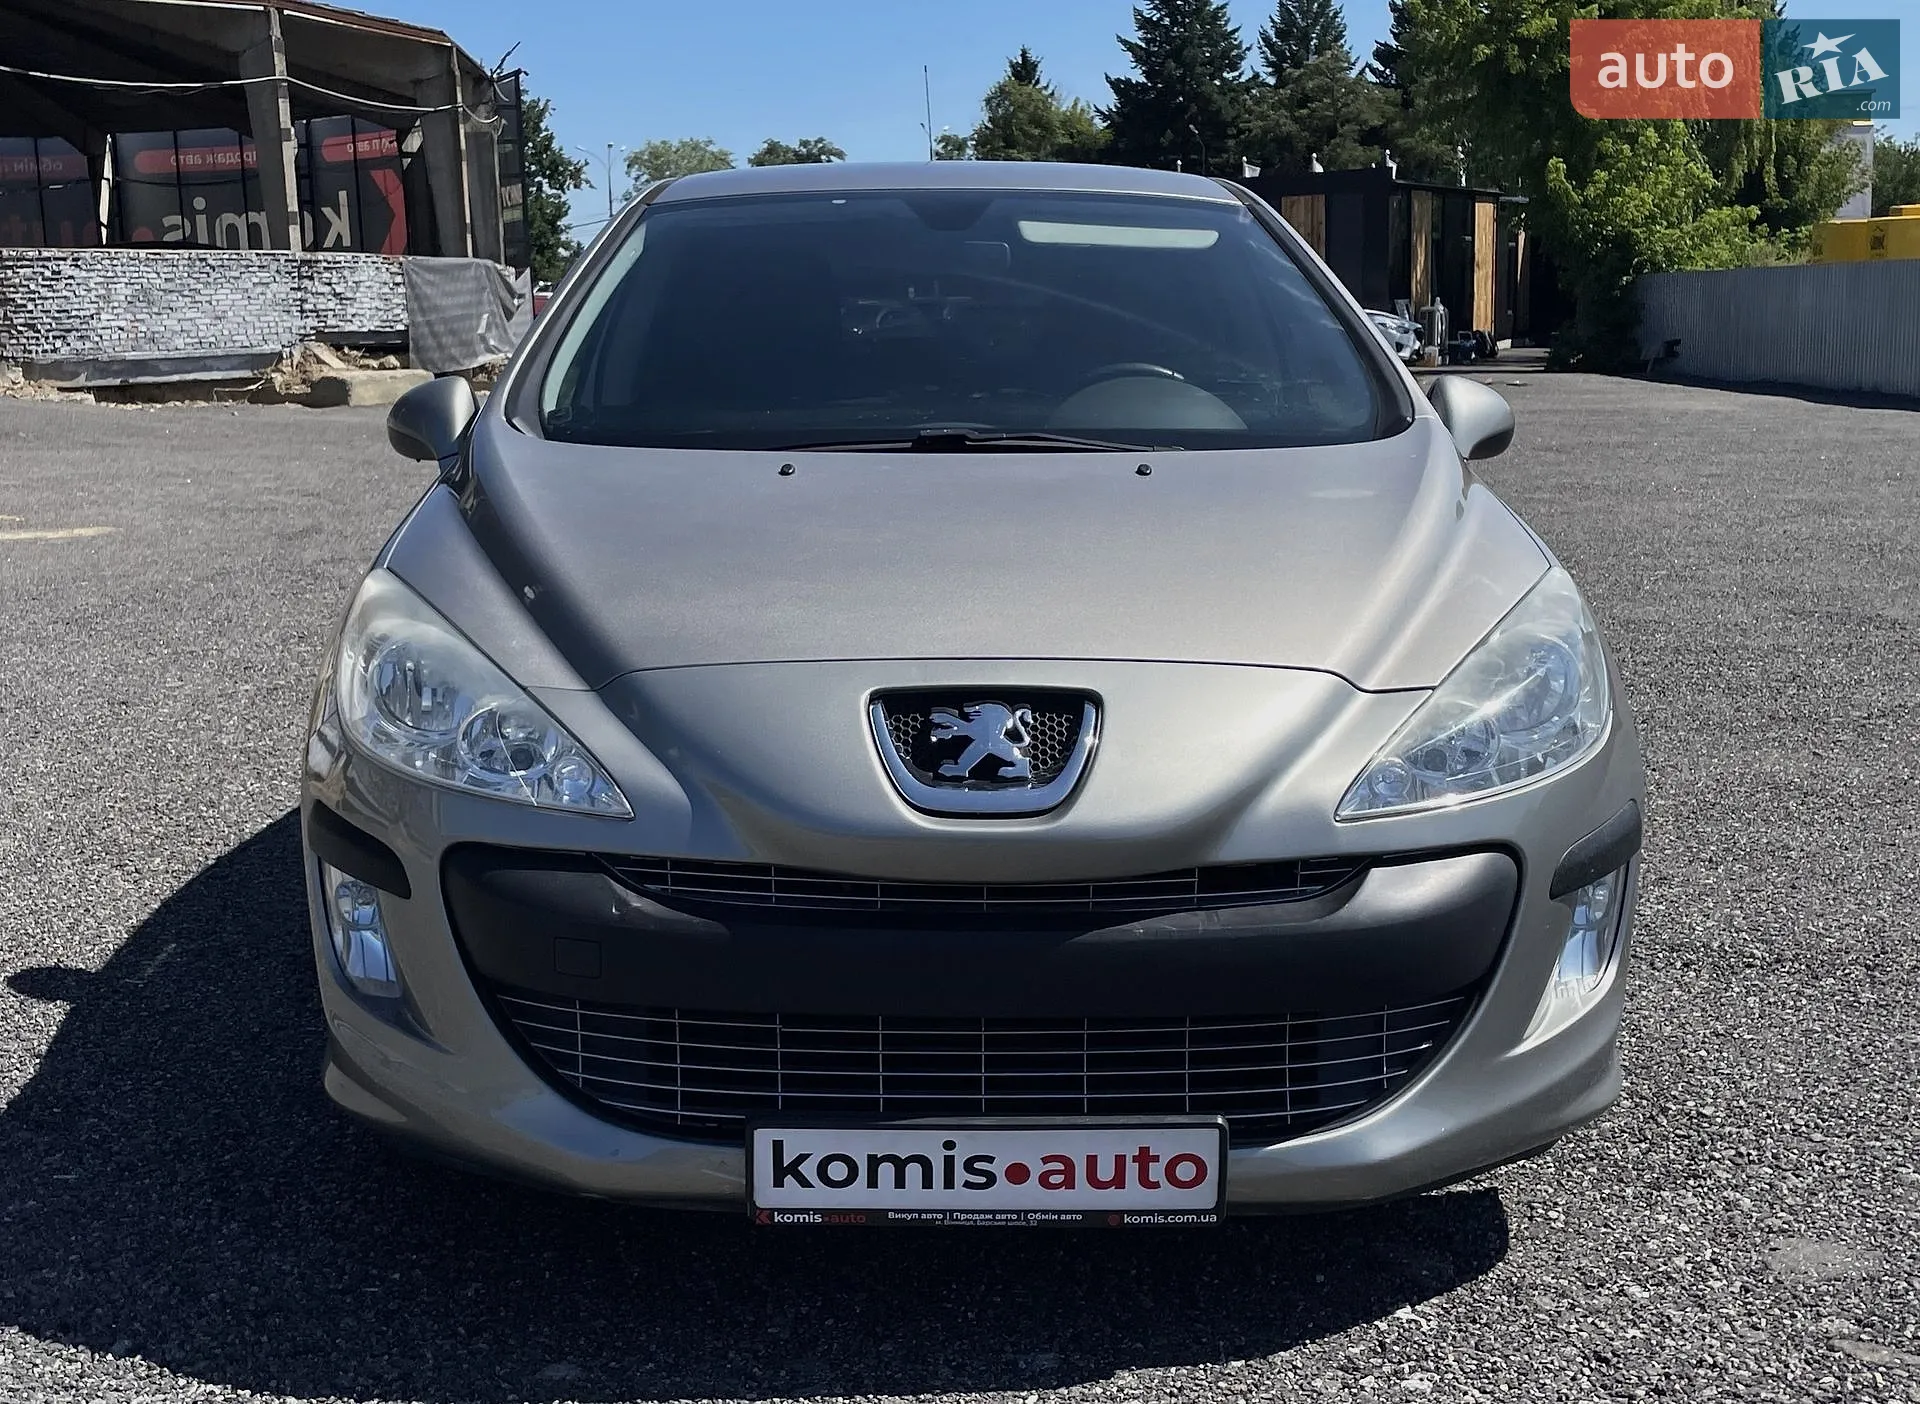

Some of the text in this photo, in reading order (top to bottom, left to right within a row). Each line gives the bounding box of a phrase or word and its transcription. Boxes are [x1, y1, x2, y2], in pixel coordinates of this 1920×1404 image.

[888, 1211, 1083, 1222] Викуп авто Продаж авто Обмін авто
[1123, 1212, 1218, 1224] komis.com.ua
